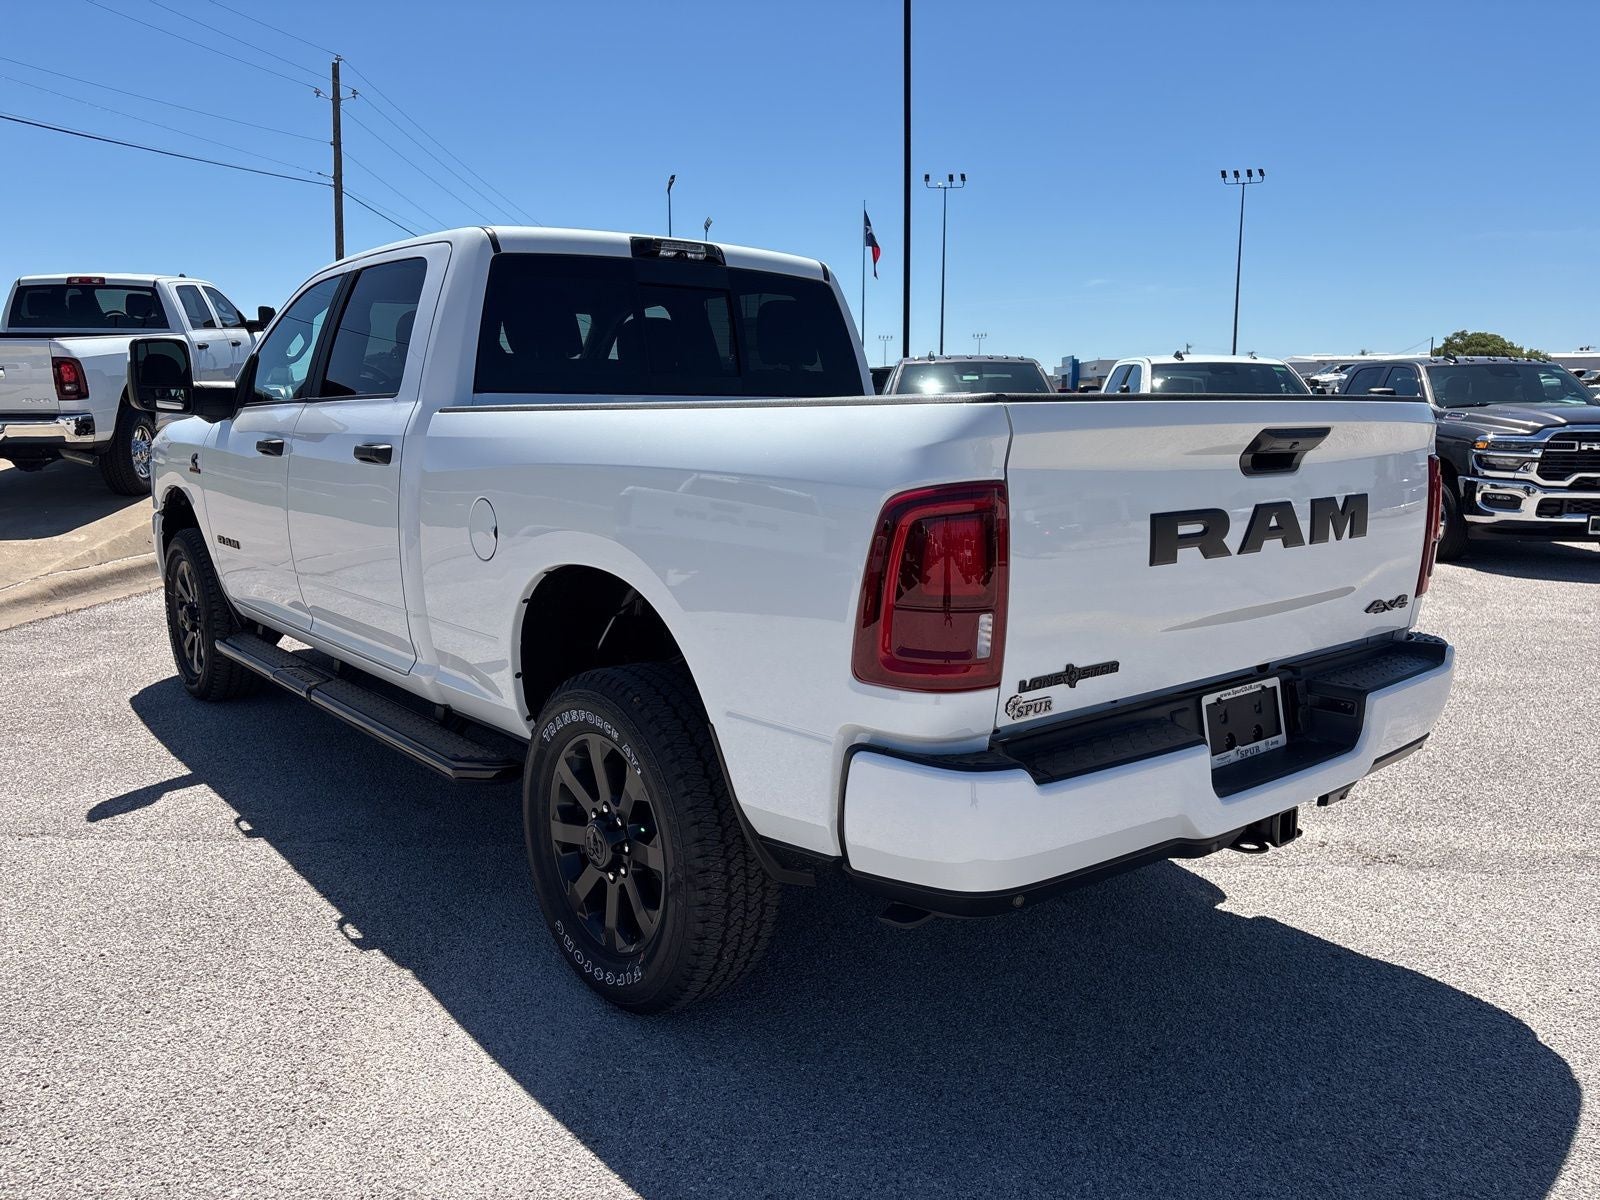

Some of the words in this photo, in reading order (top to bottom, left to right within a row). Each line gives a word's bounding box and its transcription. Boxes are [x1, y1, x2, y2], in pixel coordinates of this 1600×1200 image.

[1149, 493, 1369, 567] RAM
[217, 534, 241, 550] RAM
[1364, 594, 1409, 614] 4x4
[1018, 671, 1066, 694] LONE
[1079, 660, 1120, 680] STAR
[1016, 699, 1053, 718] SPUR
[542, 709, 620, 742] TRANSFORCE
[1239, 745, 1261, 759] SPUR
